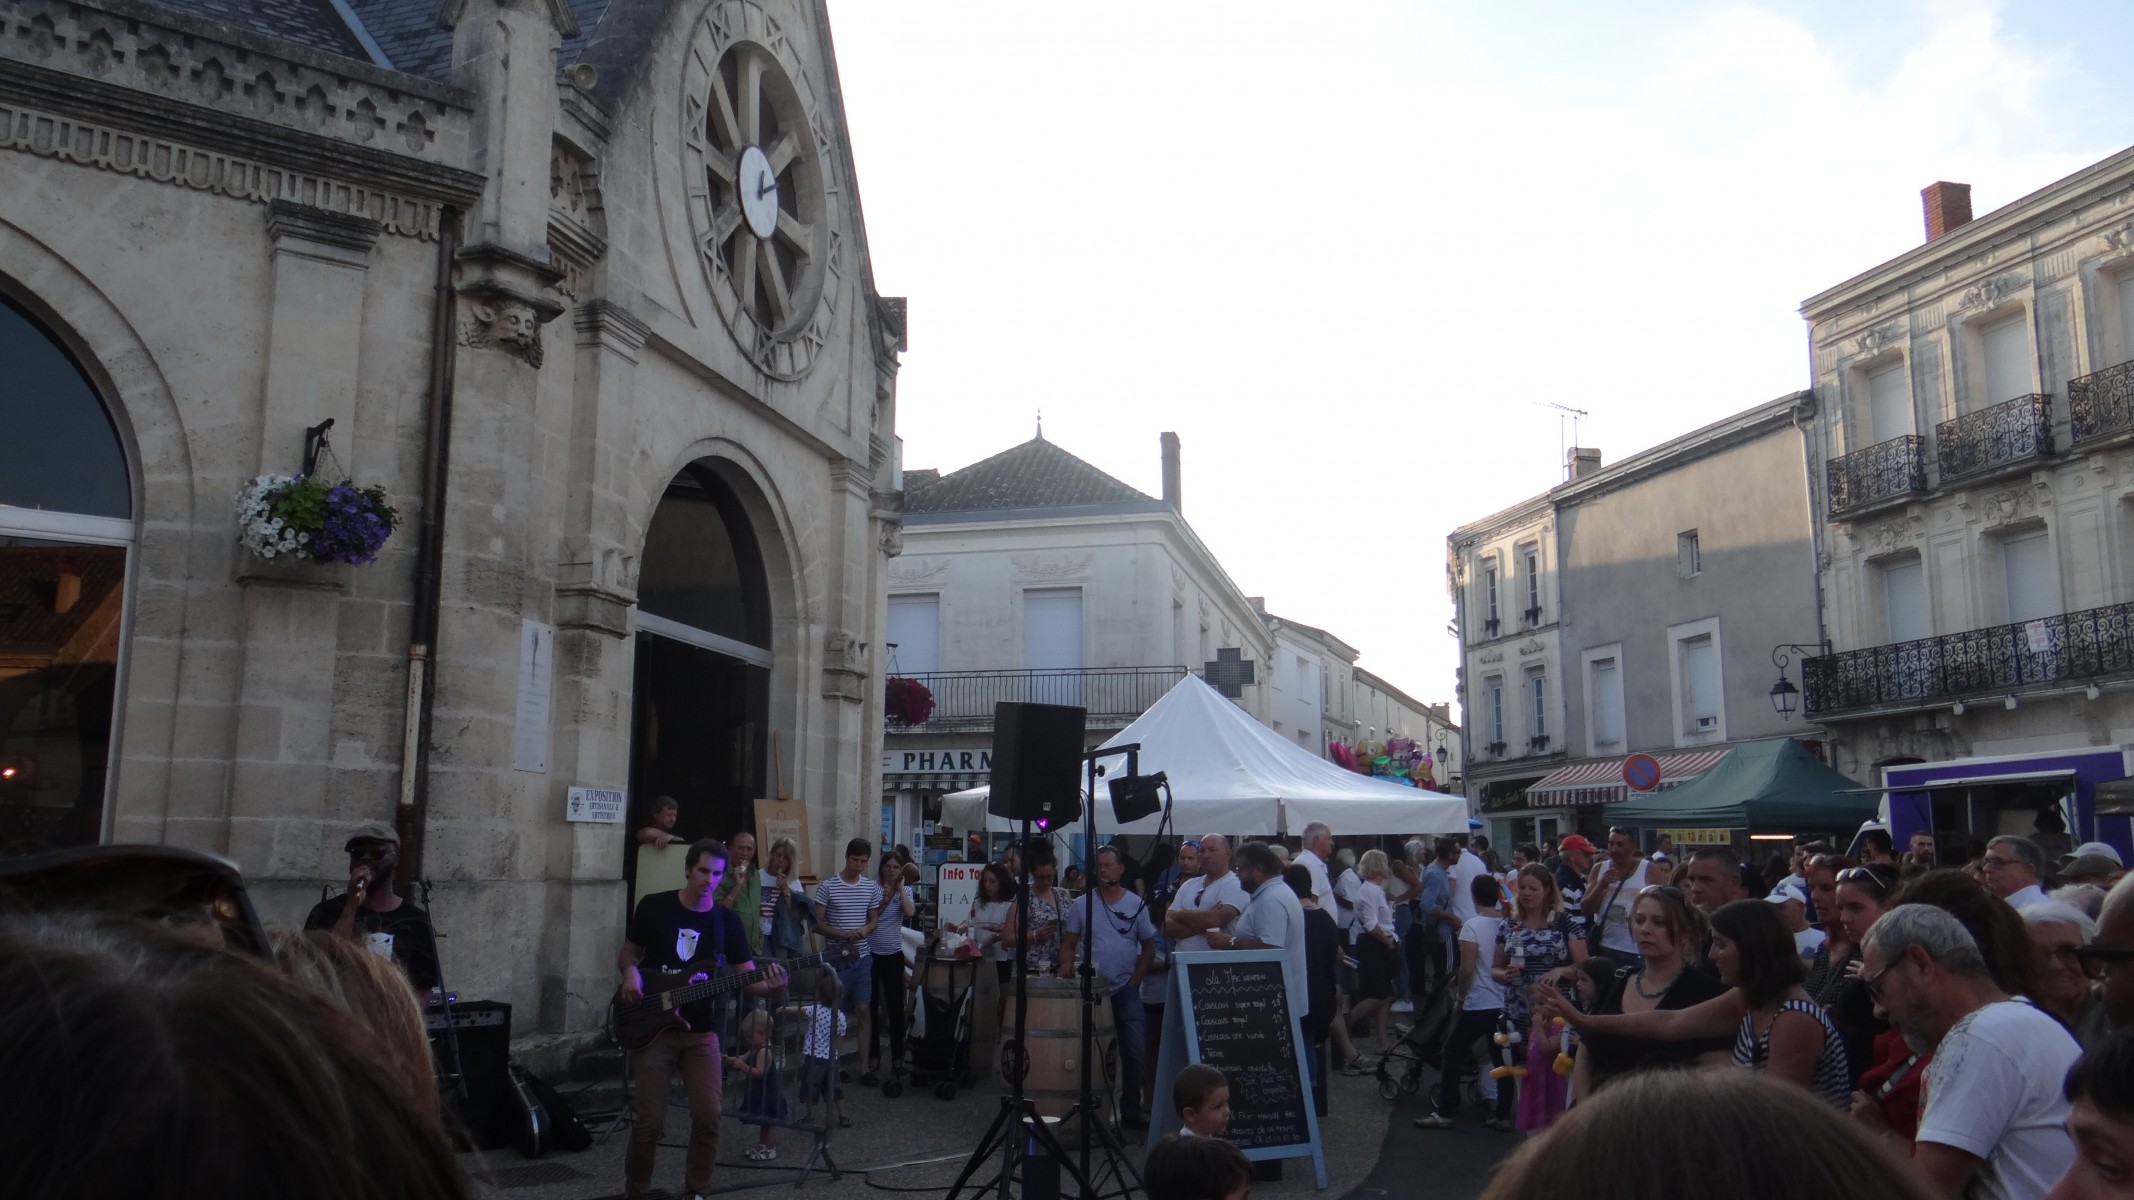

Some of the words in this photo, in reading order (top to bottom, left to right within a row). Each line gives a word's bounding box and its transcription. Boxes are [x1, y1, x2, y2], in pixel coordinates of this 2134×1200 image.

[904, 752, 991, 770] PHARM
[585, 790, 622, 802] EXPOSITION
[943, 868, 964, 880] Info
[1205, 969, 1221, 985] Le
[1199, 999, 1229, 1010] Couscous
[1200, 1014, 1228, 1025] Couscous
[1203, 1030, 1230, 1041] Couscous
[1257, 1112, 1279, 1120] MAISON
